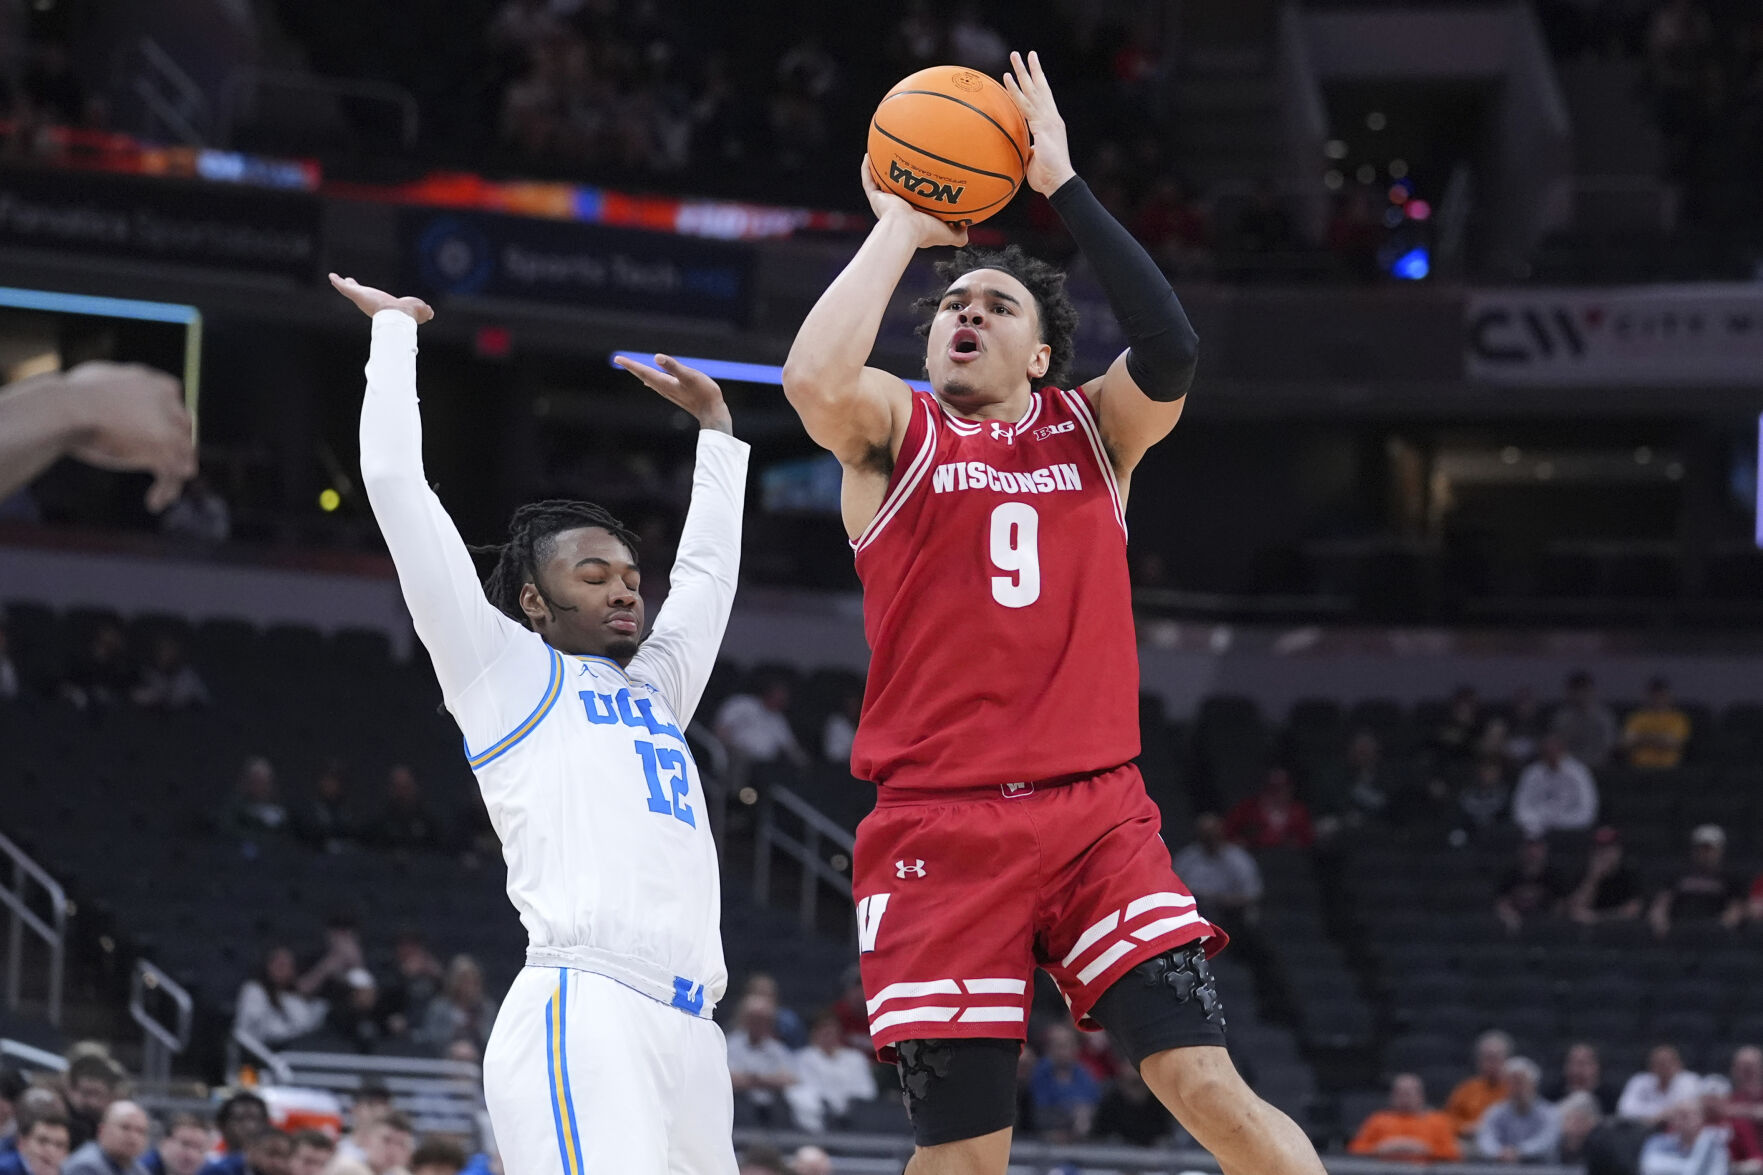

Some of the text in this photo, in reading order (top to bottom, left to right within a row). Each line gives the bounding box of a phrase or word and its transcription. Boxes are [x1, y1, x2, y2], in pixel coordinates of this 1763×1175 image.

[889, 160, 965, 205] NCAA
[932, 461, 1083, 494] WISCONSIN
[990, 502, 1040, 608] 9
[634, 739, 696, 830] 12
